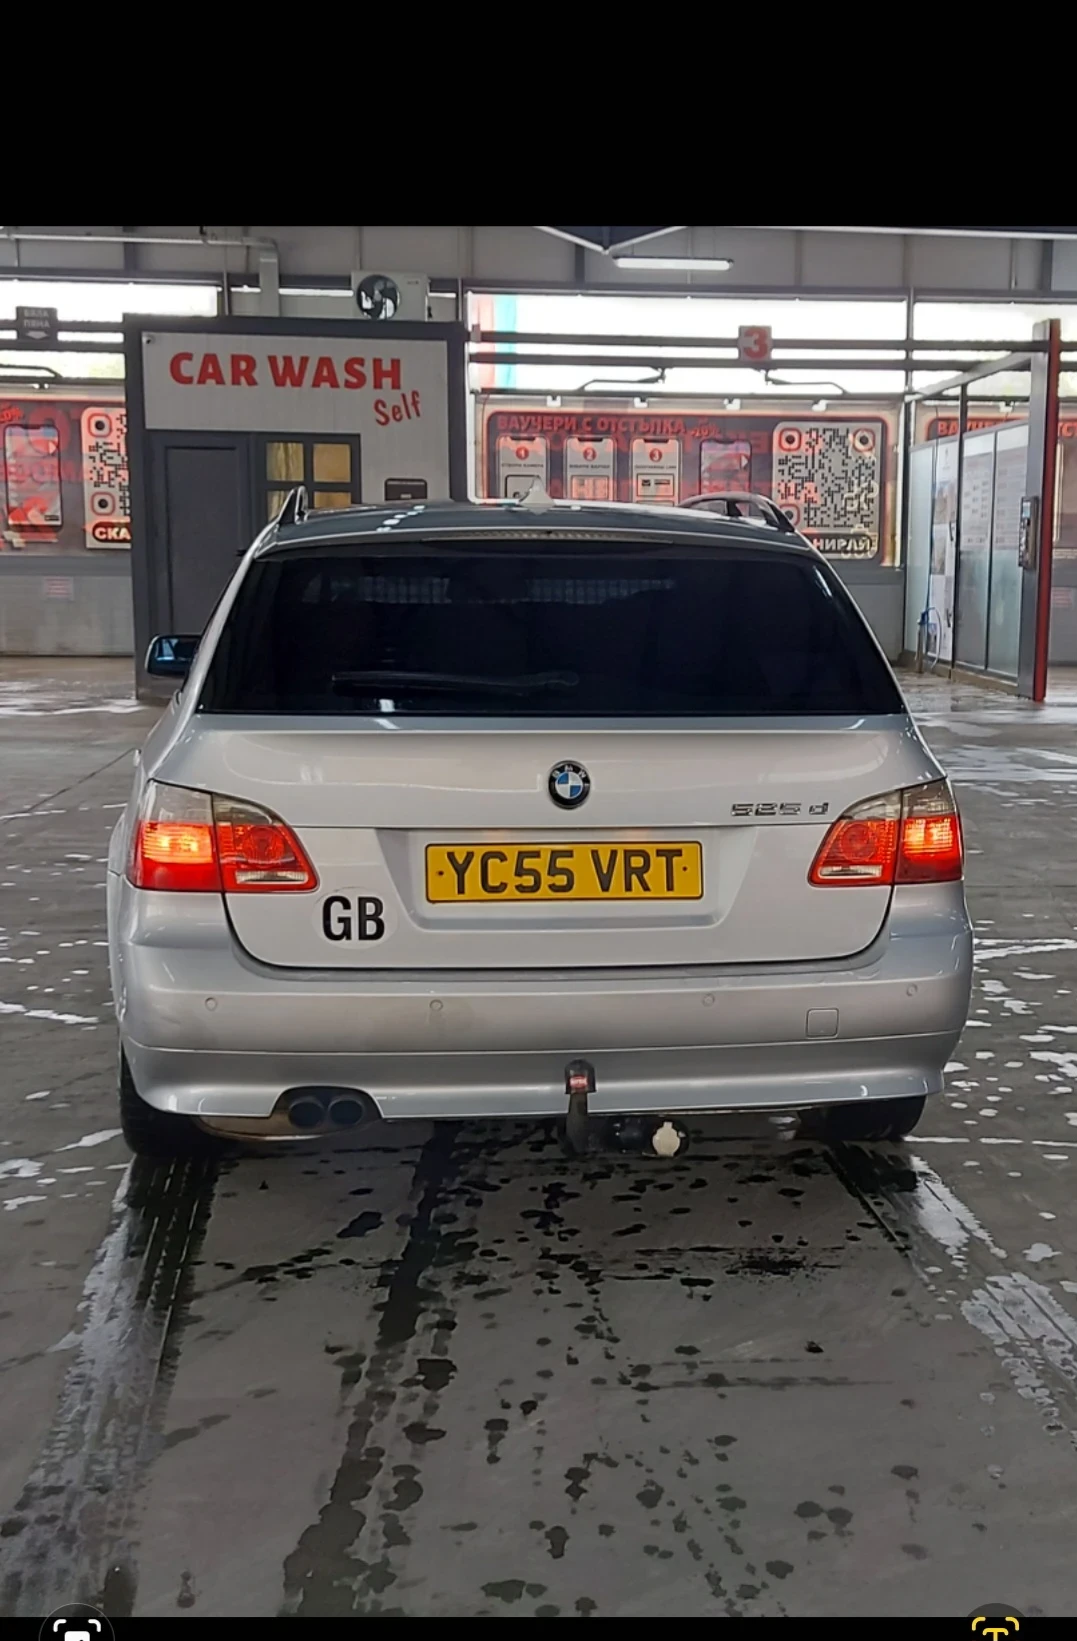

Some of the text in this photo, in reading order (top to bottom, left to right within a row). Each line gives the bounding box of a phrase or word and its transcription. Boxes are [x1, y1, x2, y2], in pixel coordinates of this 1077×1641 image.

[743, 328, 769, 360] 3
[169, 352, 402, 390] CAR WASH
[373, 390, 421, 426] Self
[497, 416, 577, 432] ВАУЧЕРИ
[581, 416, 593, 432] С
[596, 417, 686, 434] ОТСТЪПКА
[446, 849, 683, 895] YC55 VRT
[322, 895, 385, 941] GB
